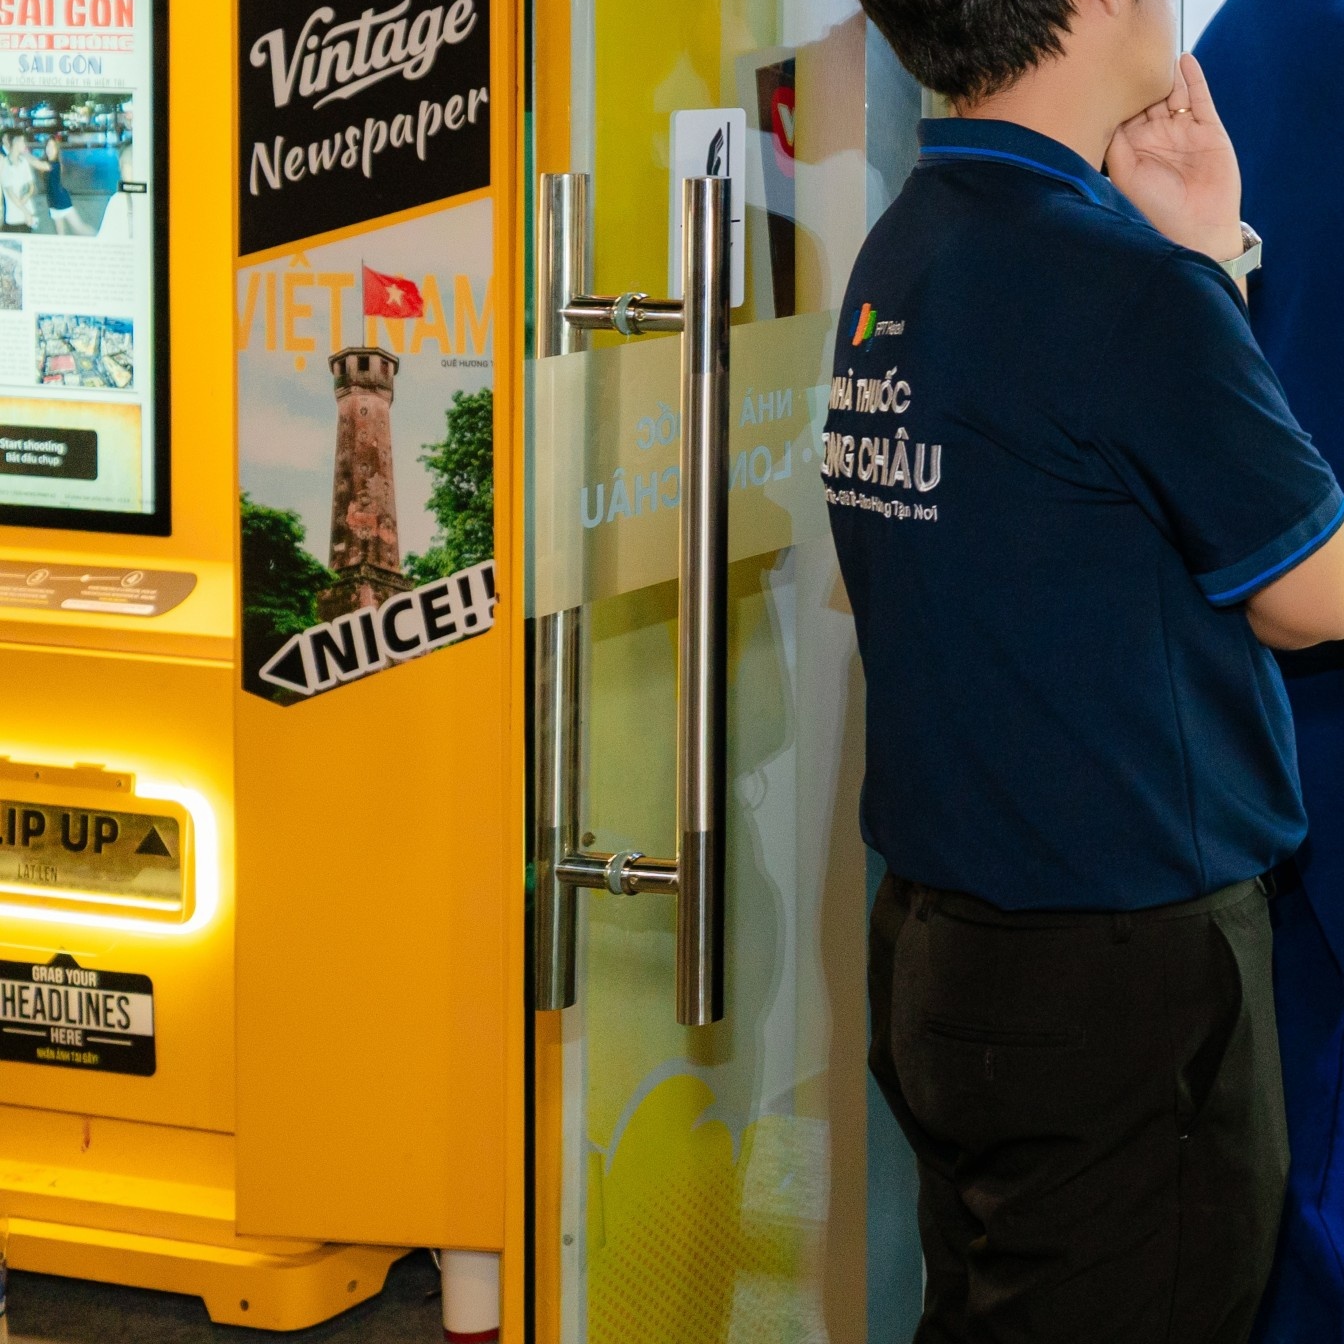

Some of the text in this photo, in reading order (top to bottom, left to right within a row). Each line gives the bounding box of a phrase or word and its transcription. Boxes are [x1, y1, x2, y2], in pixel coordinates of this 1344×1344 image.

[249, 84, 488, 196] Newspaper
[856, 365, 911, 413] THUỐC
[23, 439, 65, 455] shooting
[857, 427, 941, 492] CHÂU
[61, 813, 119, 854] UP
[32, 965, 98, 987] GRAB YOUR
[2, 982, 131, 1031] HEADLINES
[50, 1027, 83, 1046] HERE
